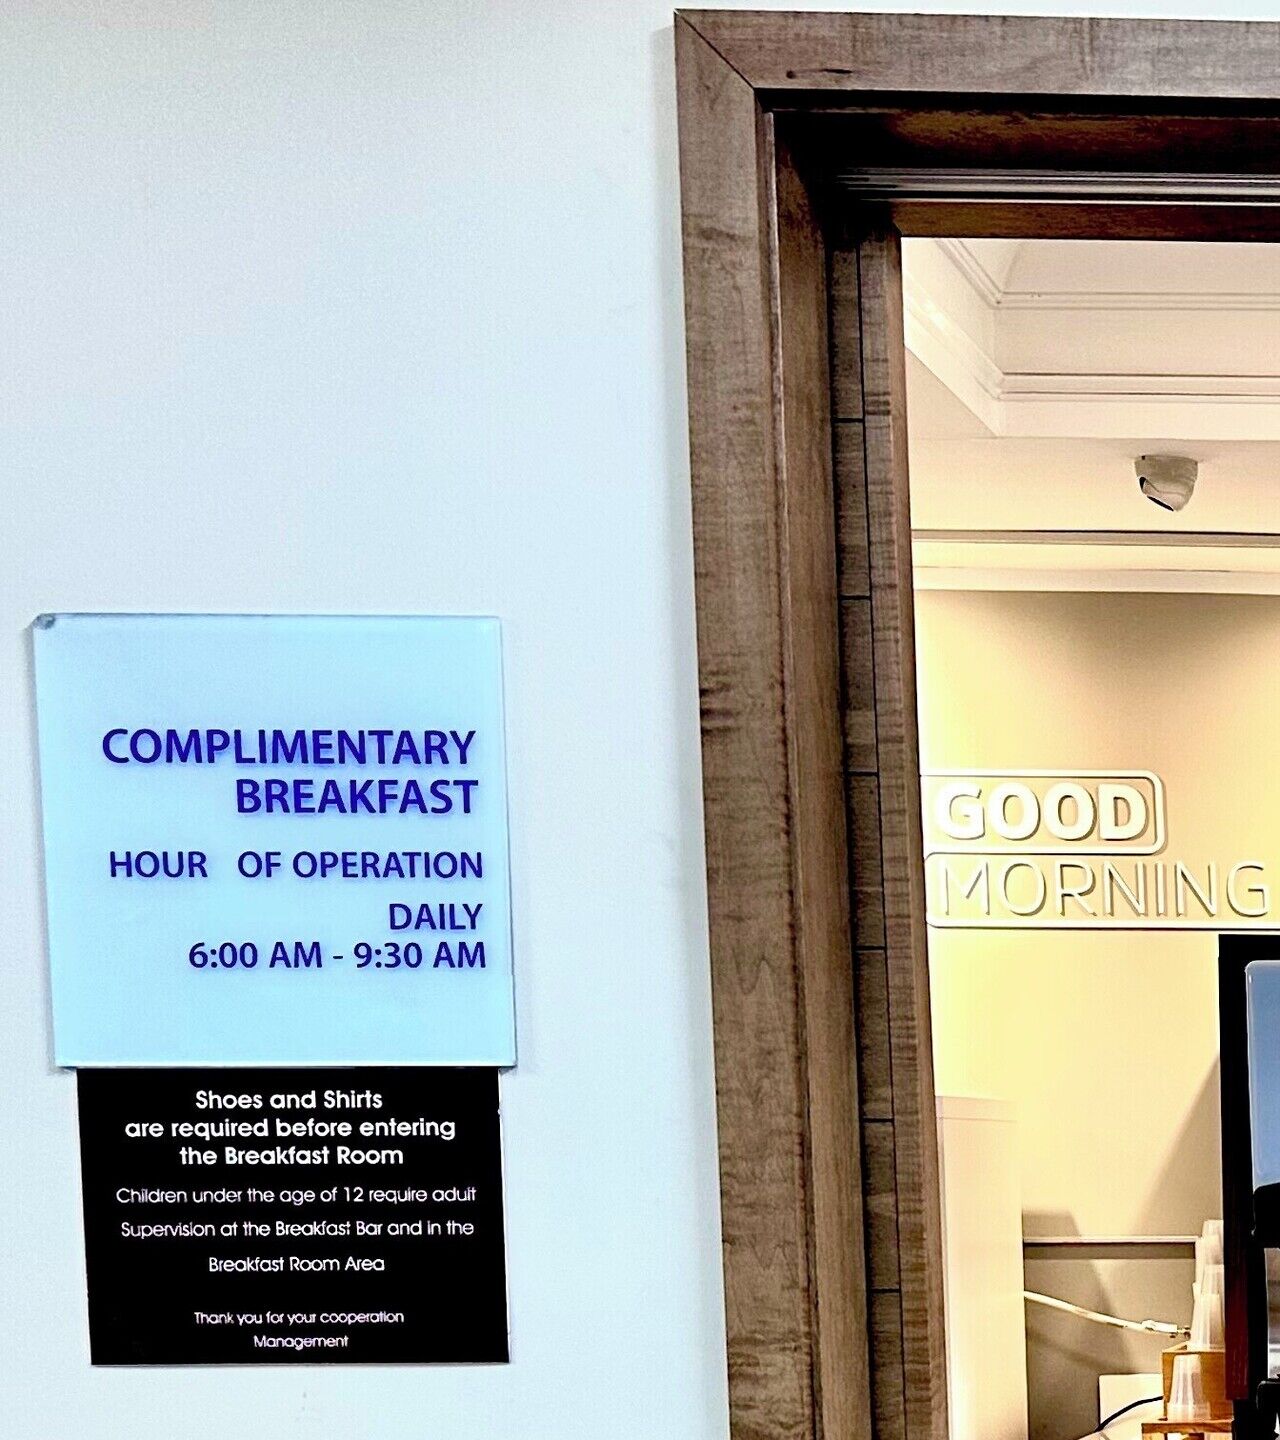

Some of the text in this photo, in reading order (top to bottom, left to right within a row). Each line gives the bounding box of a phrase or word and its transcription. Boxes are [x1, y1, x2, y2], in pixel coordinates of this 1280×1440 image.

[103, 729, 476, 764] COMPLIMENTARY
[236, 779, 478, 814] BREAKFAST
[935, 781, 1149, 840] GOOD
[110, 851, 482, 878] HOUR OF OPERATION
[935, 860, 1271, 917] MORNING
[390, 904, 483, 930] DAILY
[189, 942, 257, 968] 6:00
[269, 942, 322, 968] AM
[354, 942, 422, 968] 9:30
[433, 942, 486, 968] AM
[196, 1090, 382, 1109] Shoes and Shirts
[125, 1118, 455, 1141] are required before entering
[179, 1146, 403, 1165] the Breakfast Room
[116, 1187, 476, 1205] Children under the age of 12 require adult
[122, 1220, 474, 1239] Supervision at the Breakfast Bar and in the
[209, 1256, 385, 1272] Breakfast Room Area
[194, 1311, 404, 1326] Thank you for your cooperation
[254, 1335, 349, 1350] Management
